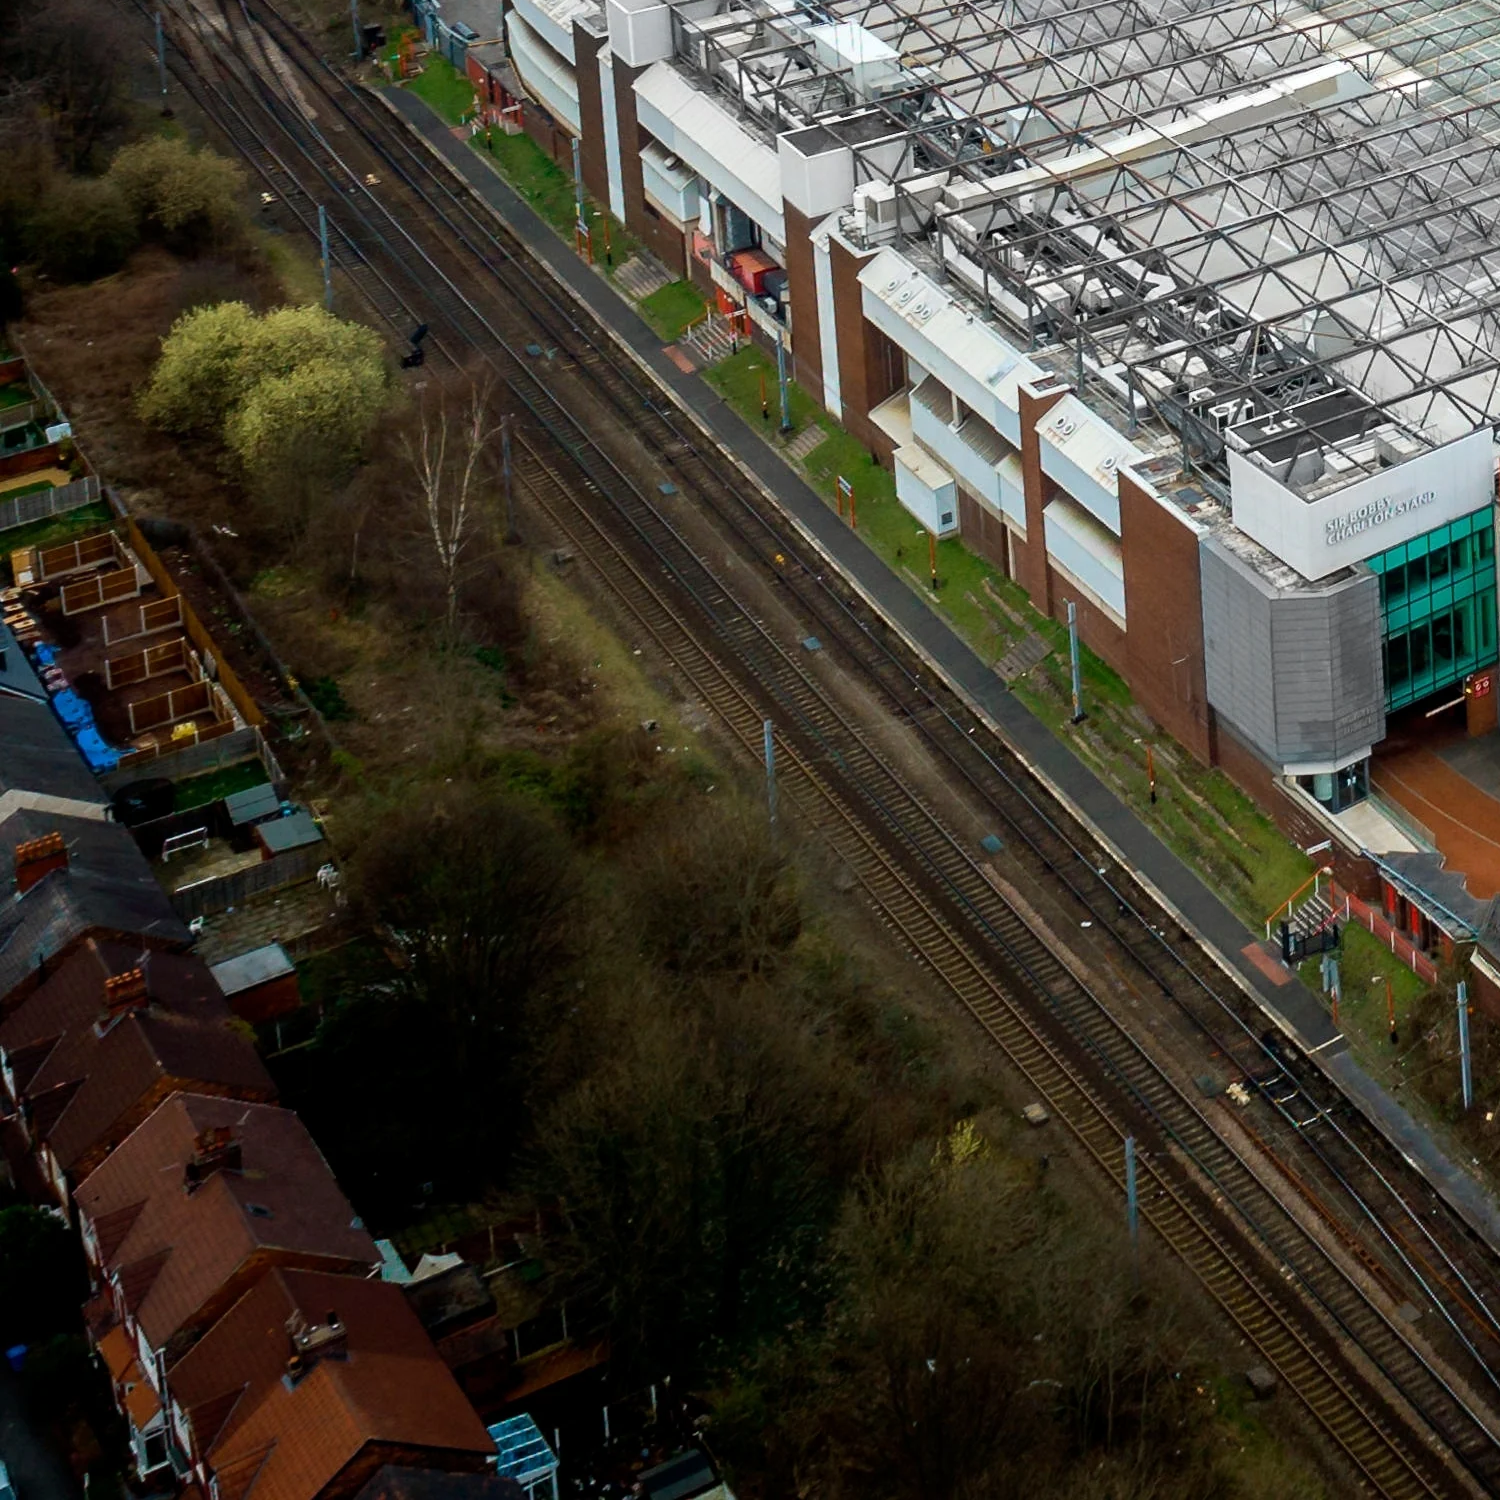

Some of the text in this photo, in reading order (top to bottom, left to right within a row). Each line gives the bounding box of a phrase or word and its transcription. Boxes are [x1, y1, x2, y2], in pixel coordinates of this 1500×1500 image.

[1326, 495, 1394, 534] SIR BOBBY
[1326, 490, 1438, 547] CHARLTON STAND
